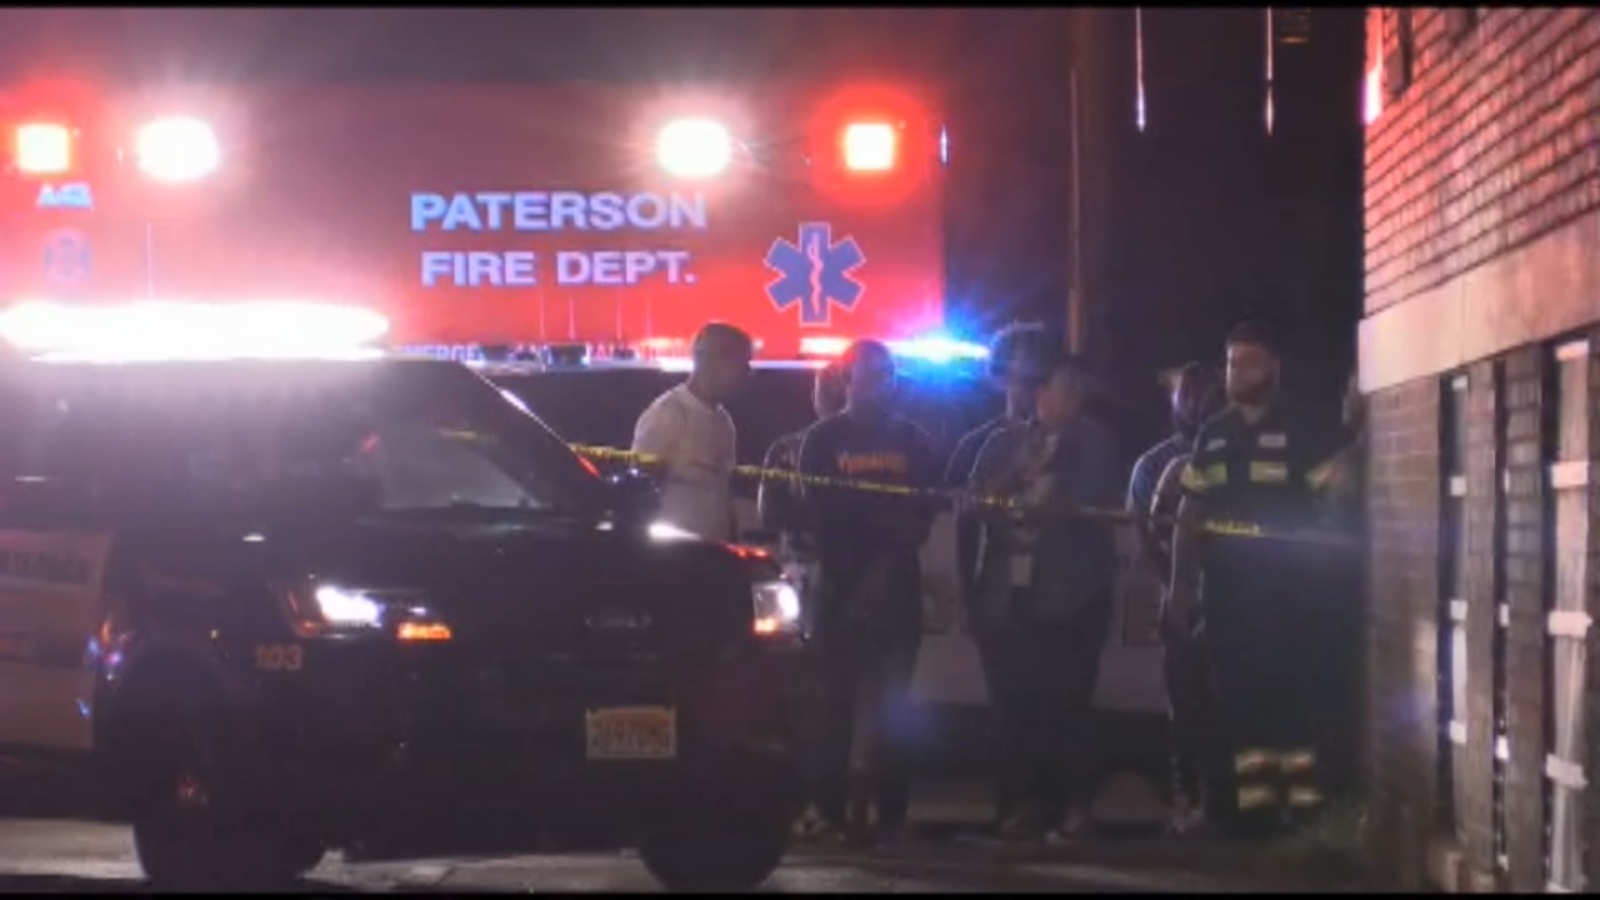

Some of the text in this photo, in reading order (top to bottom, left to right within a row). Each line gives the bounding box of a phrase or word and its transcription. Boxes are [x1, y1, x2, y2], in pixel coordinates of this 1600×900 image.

[411, 191, 707, 231] PATERSON
[421, 250, 696, 287] FIRE DEPT.
